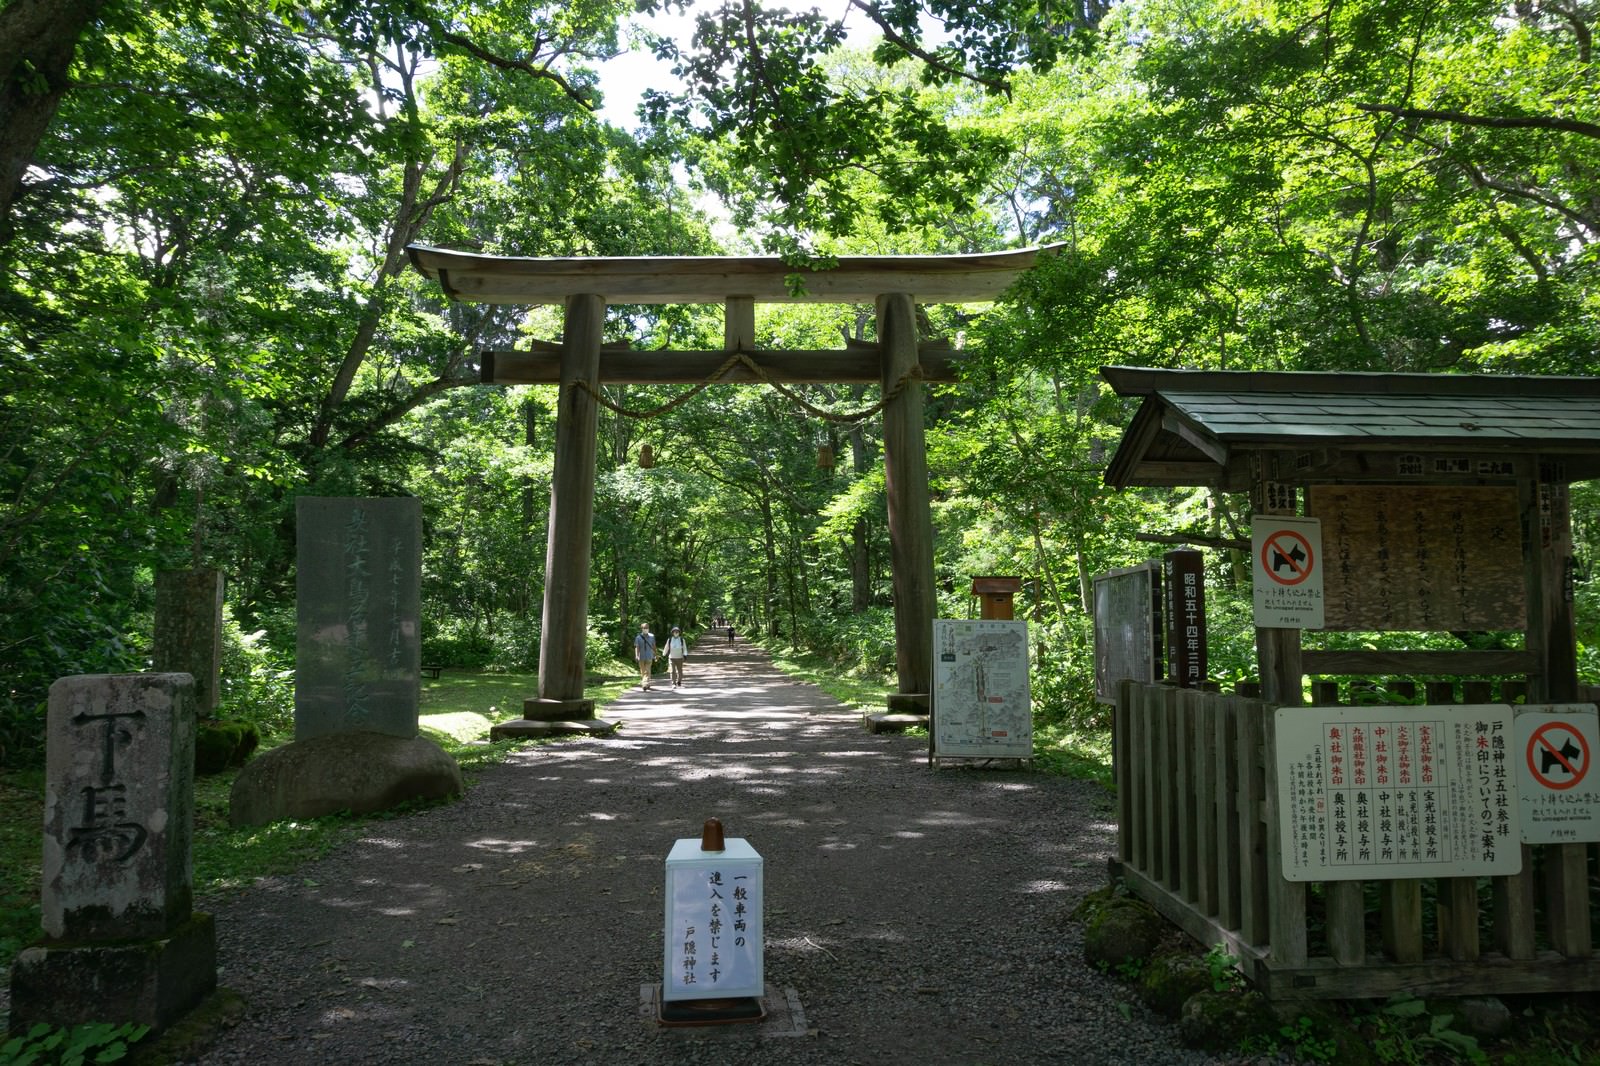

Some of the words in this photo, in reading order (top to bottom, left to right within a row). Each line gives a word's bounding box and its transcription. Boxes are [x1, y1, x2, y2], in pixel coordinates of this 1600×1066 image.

[65, 709, 148, 864] 下馬
[1329, 727, 1343, 786] 奥社御朱印
[1375, 727, 1388, 785] 中社御朱印
[1419, 725, 1433, 785] 宝光社御朱印
[1491, 721, 1511, 837] 戸隠神社五社参拝
[1334, 791, 1349, 862] 奥社授与所
[1356, 791, 1371, 861] 奥社授与所
[1379, 791, 1393, 860] 中社授与所
[1396, 790, 1408, 860] 中社授与所
[1408, 790, 1420, 861] 宝光社授与所
[1423, 789, 1438, 859] 宝光社授与所
[1475, 720, 1496, 863] 御朱印についてのご案内
[708, 871, 724, 983] 進入を禁じます
[732, 874, 749, 948] 一般車両の
[683, 926, 697, 985] 戸隠神社
